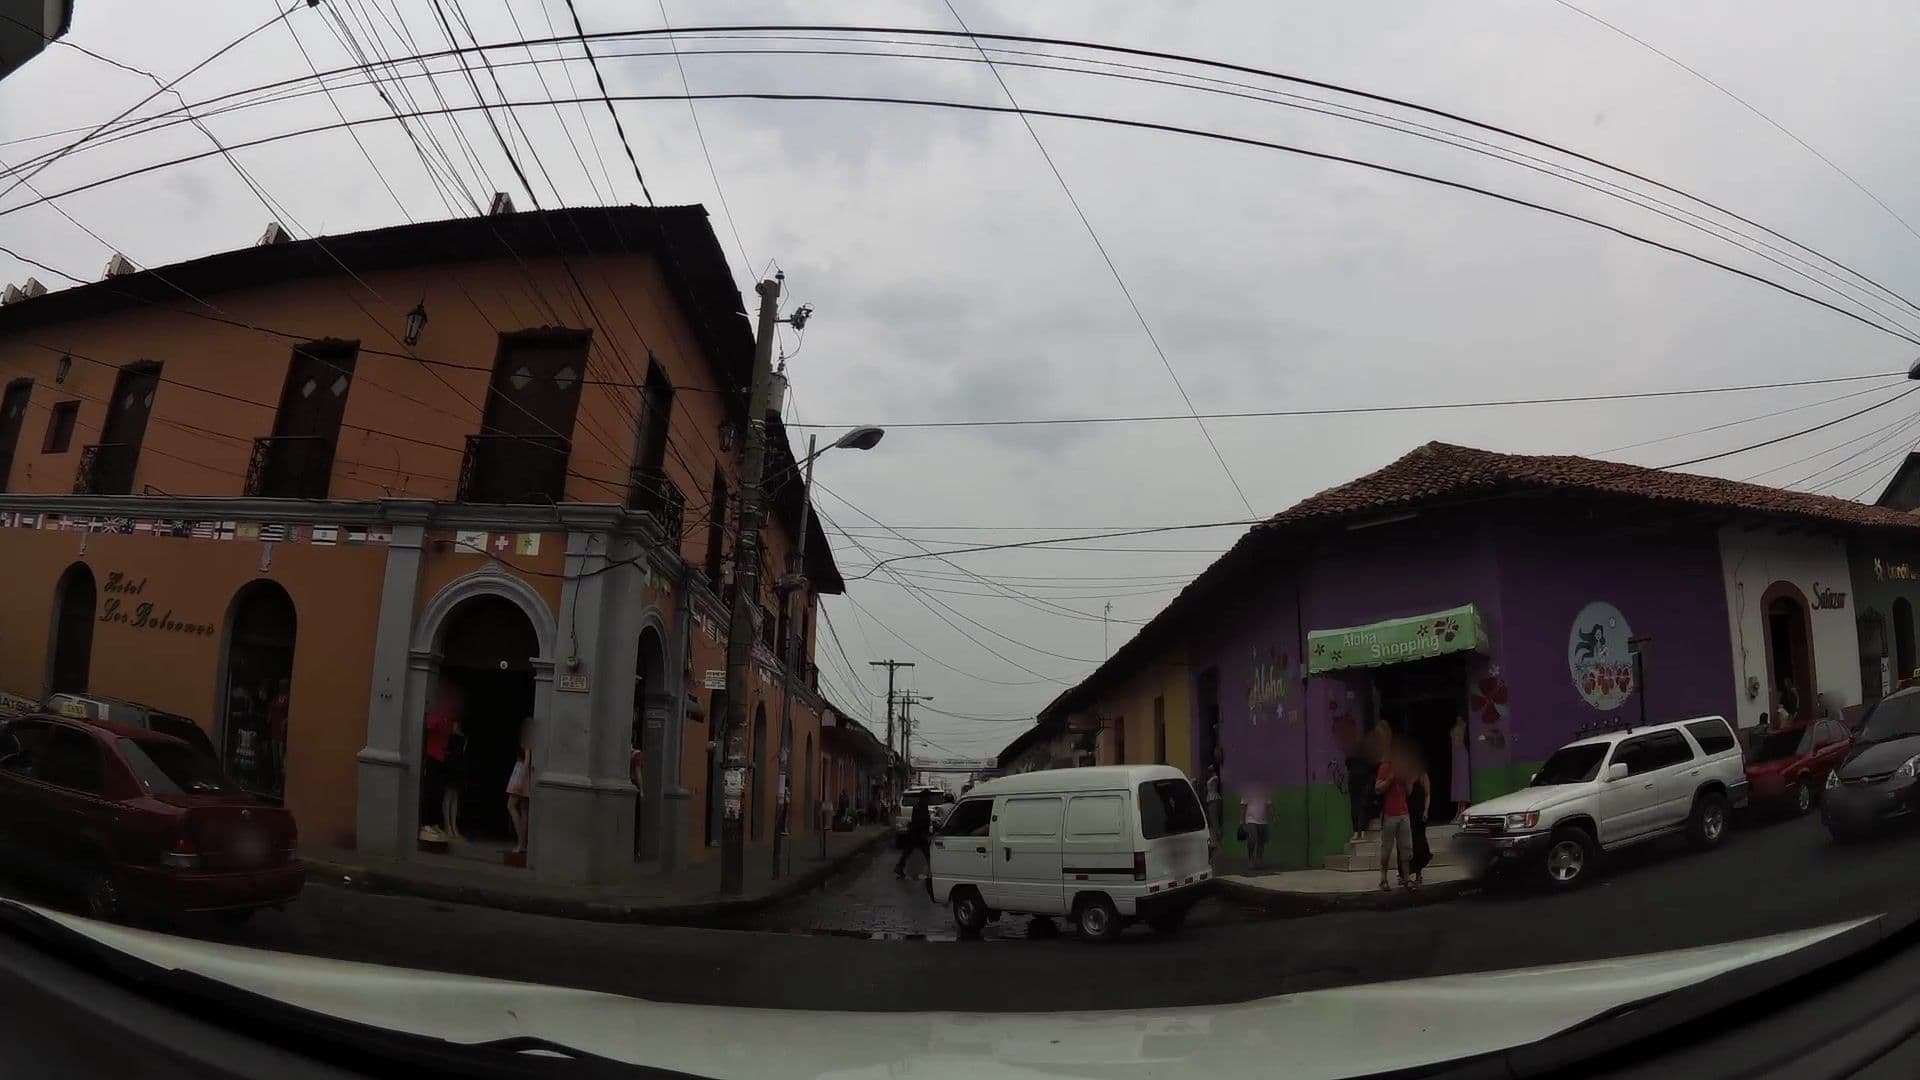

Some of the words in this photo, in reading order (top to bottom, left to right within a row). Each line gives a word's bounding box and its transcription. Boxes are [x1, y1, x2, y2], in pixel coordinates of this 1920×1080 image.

[104, 571, 147, 594] Hotel
[99, 598, 128, 622] Los
[1344, 630, 1378, 648] Aloha
[1371, 635, 1440, 658] Shopping
[1248, 664, 1287, 702] Aloha
